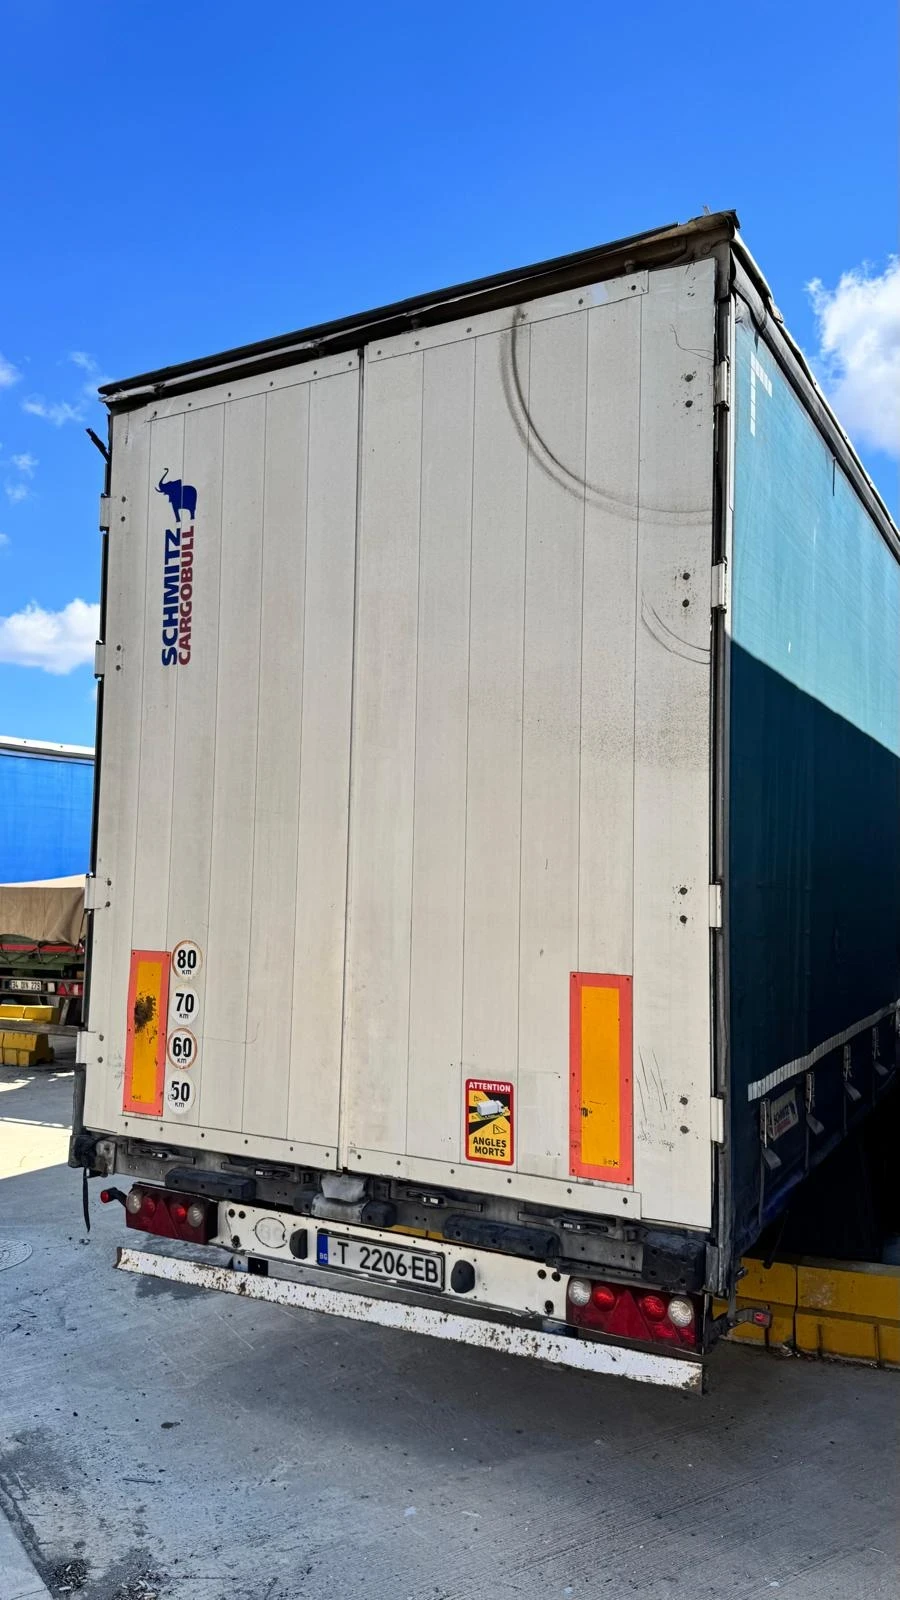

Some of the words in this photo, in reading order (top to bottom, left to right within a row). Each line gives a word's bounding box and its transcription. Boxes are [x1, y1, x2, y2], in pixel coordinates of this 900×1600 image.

[162, 527, 181, 666] SCHMITZ
[178, 525, 195, 666] CARGOBULL
[177, 949, 197, 969] 80
[175, 992, 195, 1013] 70
[172, 1036, 192, 1058] 60
[171, 1080, 190, 1102] 50
[468, 1081, 511, 1093] ATTENTION
[472, 1136, 507, 1149] ANGLES
[474, 1145, 506, 1158] MORTS
[337, 1241, 349, 1265] T
